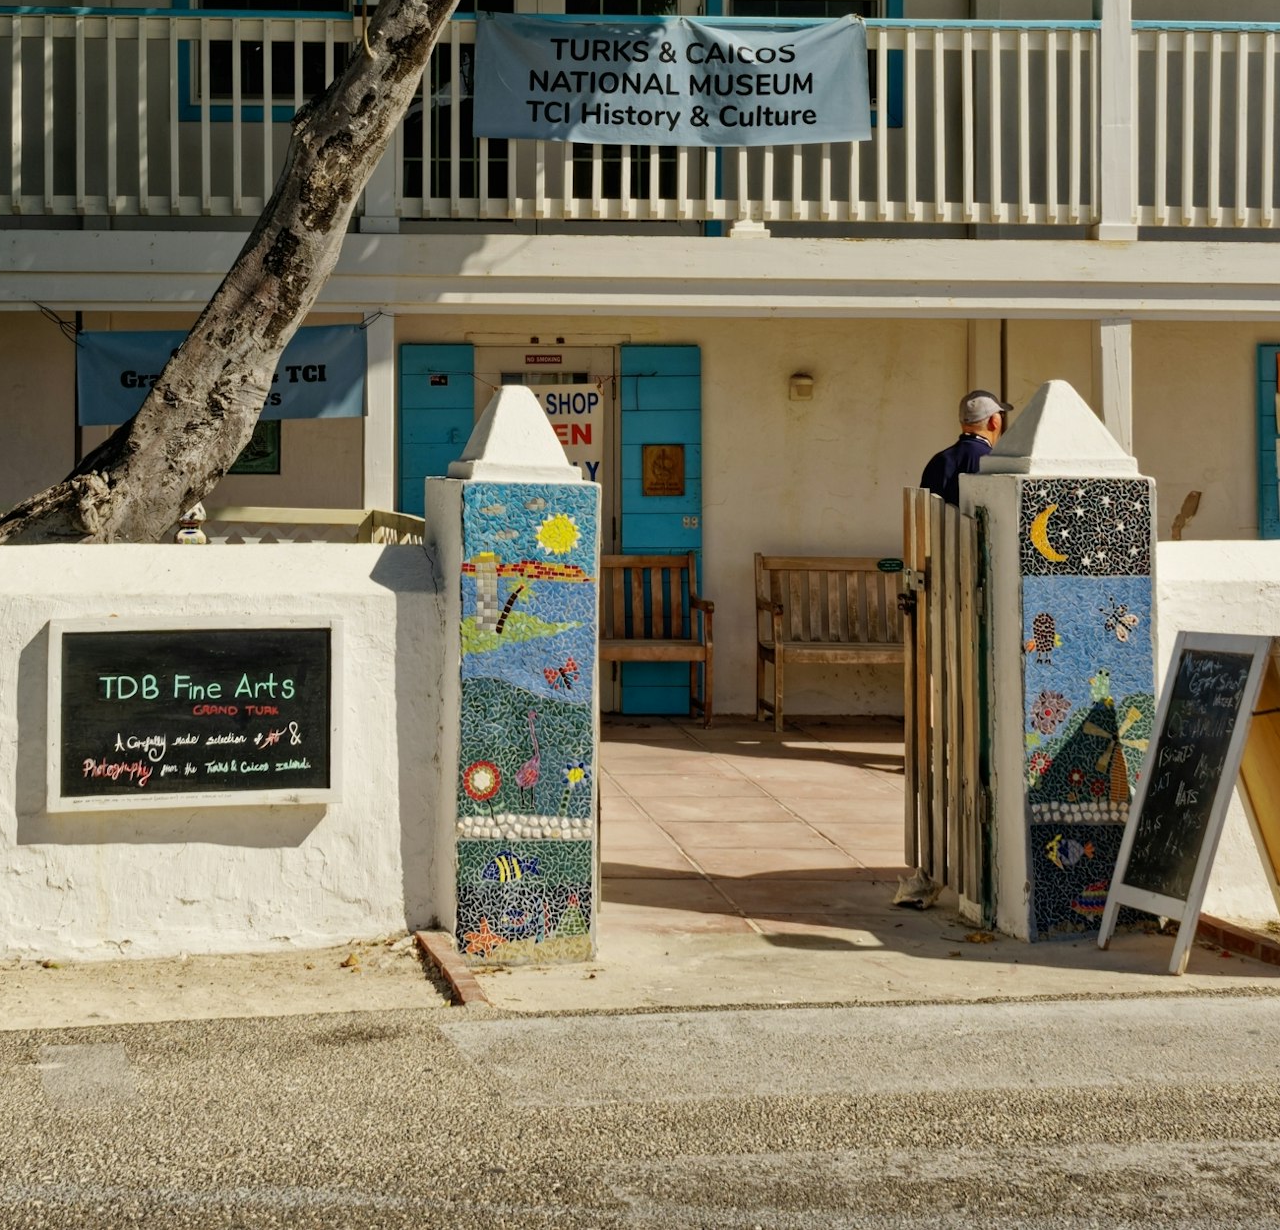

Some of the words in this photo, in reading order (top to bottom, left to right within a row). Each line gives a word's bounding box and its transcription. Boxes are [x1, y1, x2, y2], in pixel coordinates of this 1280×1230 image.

[550, 38, 649, 63] TURKS
[660, 42, 677, 64] &
[686, 43, 796, 64] CAICOS
[529, 70, 679, 96] NATIONAL
[689, 73, 813, 96] MUSEUM
[526, 101, 570, 124] TCI
[581, 102, 681, 131] History
[690, 106, 709, 127] &
[719, 105, 818, 127] Culture
[120, 370, 160, 388] Gra
[285, 364, 327, 383] TCI
[546, 392, 599, 415] SHOP
[552, 423, 592, 445] EN
[99, 674, 159, 700] TDB
[173, 674, 222, 700] Fine
[234, 672, 295, 700] Arts
[192, 705, 238, 716] GRAND
[114, 732, 125, 752] A
[288, 721, 302, 745] &
[82, 757, 153, 786] Photography
[184, 762, 197, 775] the
